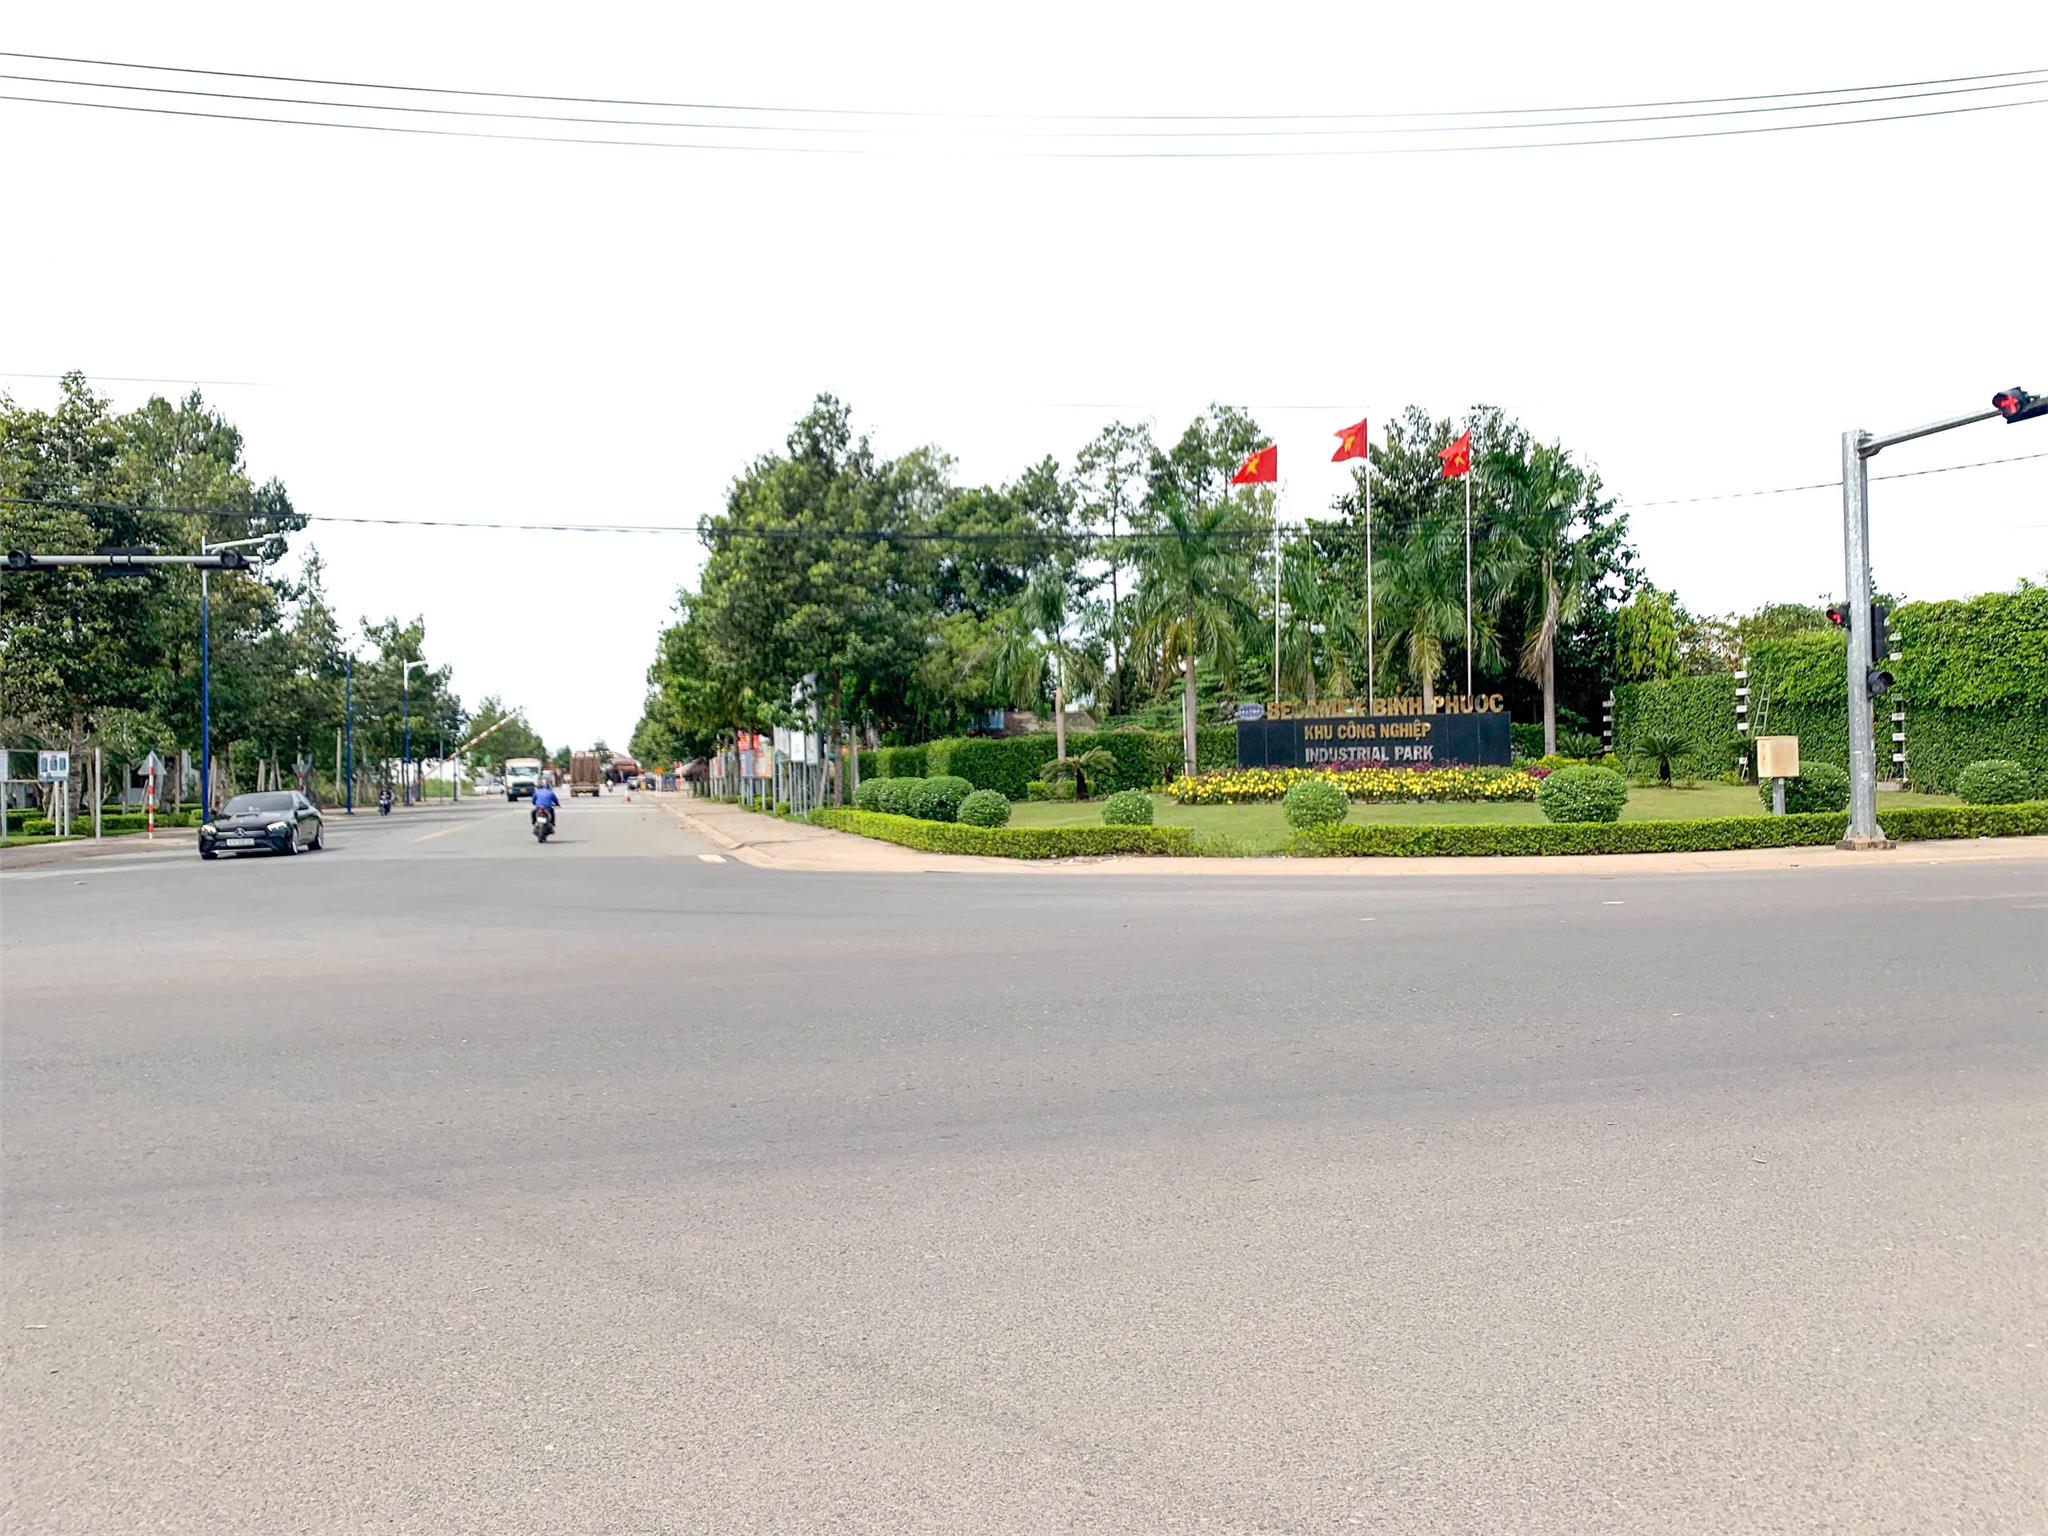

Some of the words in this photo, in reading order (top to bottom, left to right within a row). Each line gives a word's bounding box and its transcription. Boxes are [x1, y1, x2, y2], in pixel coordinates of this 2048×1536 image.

[1304, 724, 1333, 740] KHU
[1337, 720, 1376, 740] CÔNG
[1380, 719, 1432, 741] NGHIỆP
[1305, 746, 1389, 763] INDUSTRIAL
[1394, 745, 1434, 761] PARK
